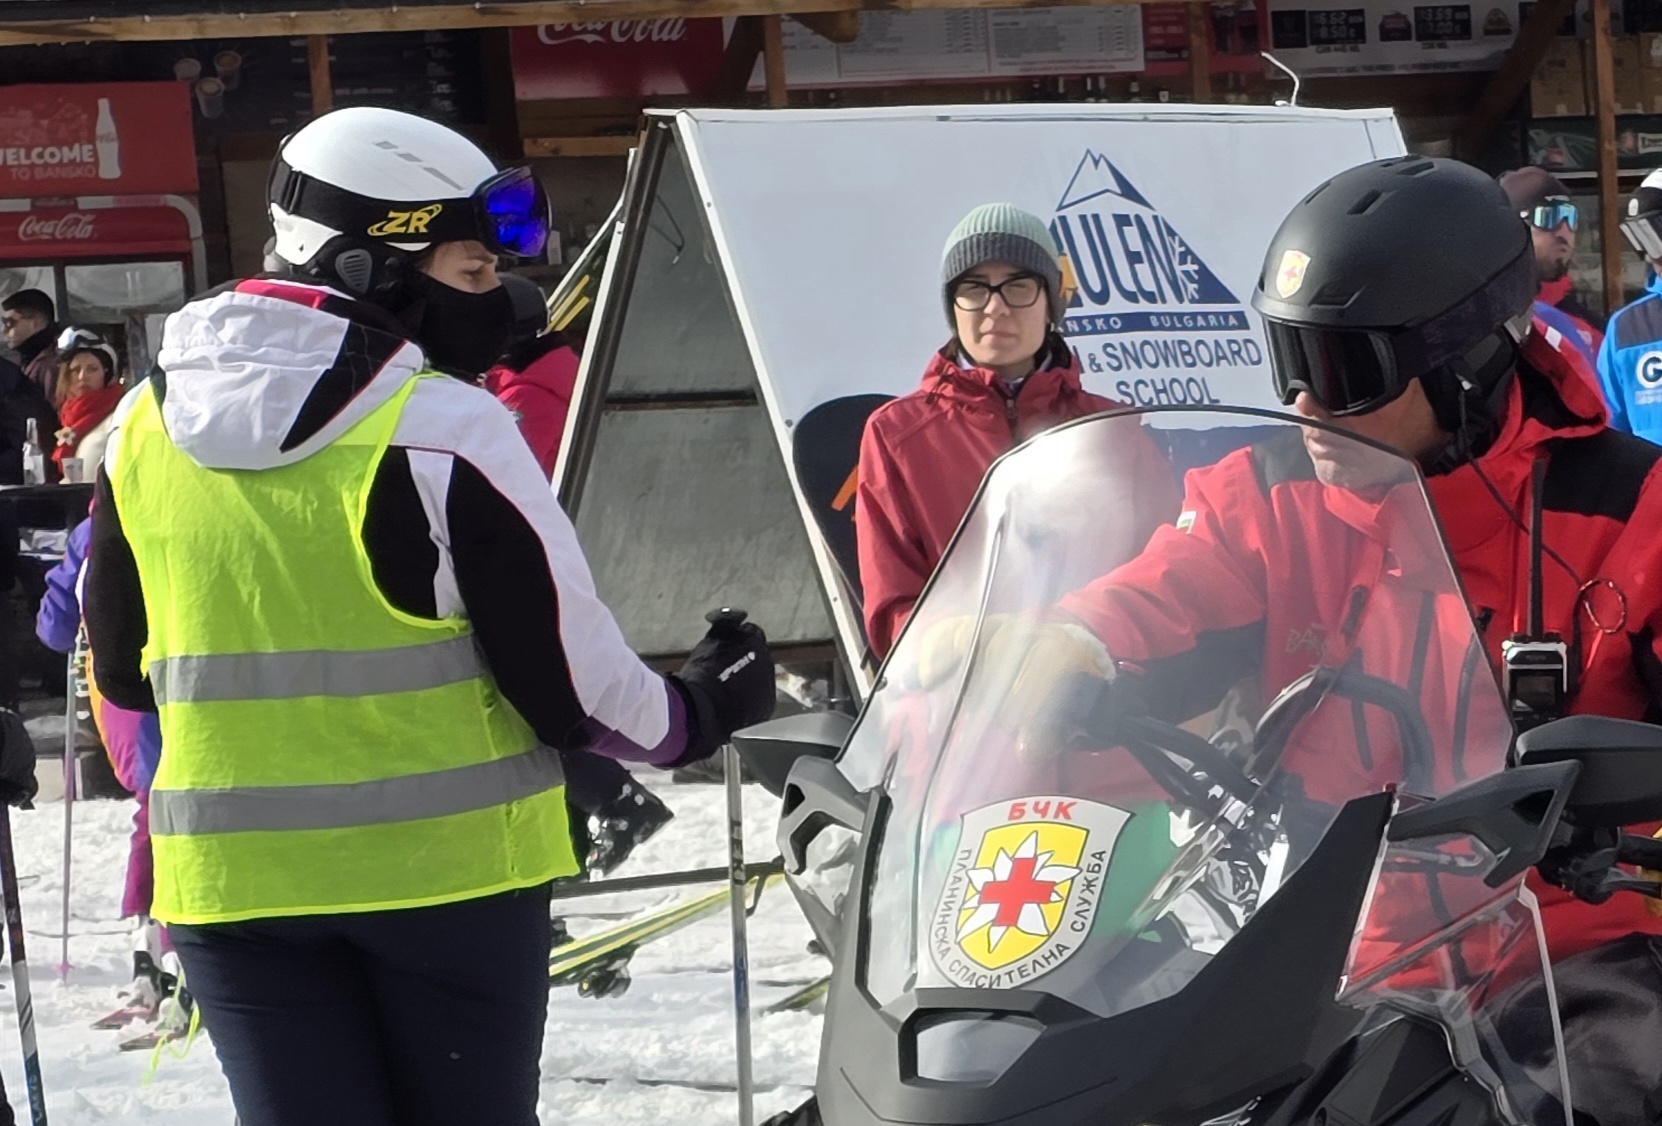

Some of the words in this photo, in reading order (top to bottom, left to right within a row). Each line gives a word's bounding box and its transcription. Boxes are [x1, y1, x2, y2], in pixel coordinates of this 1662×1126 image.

[10, 168, 31, 181] TO
[34, 165, 96, 180] BANSKO
[1058, 317, 1123, 333] NSKO
[1149, 315, 1239, 328] BULGARIA
[1088, 353, 1104, 373] &
[1102, 338, 1263, 372] SNOWBOARD
[1115, 376, 1221, 406] SCHOOL
[1007, 800, 1077, 821] БЧК
[934, 849, 973, 961] ПЛАНИНСКА
[1070, 850, 1107, 933] СЛУЖБА
[948, 943, 1071, 989] СПАСИТЕЛНА
